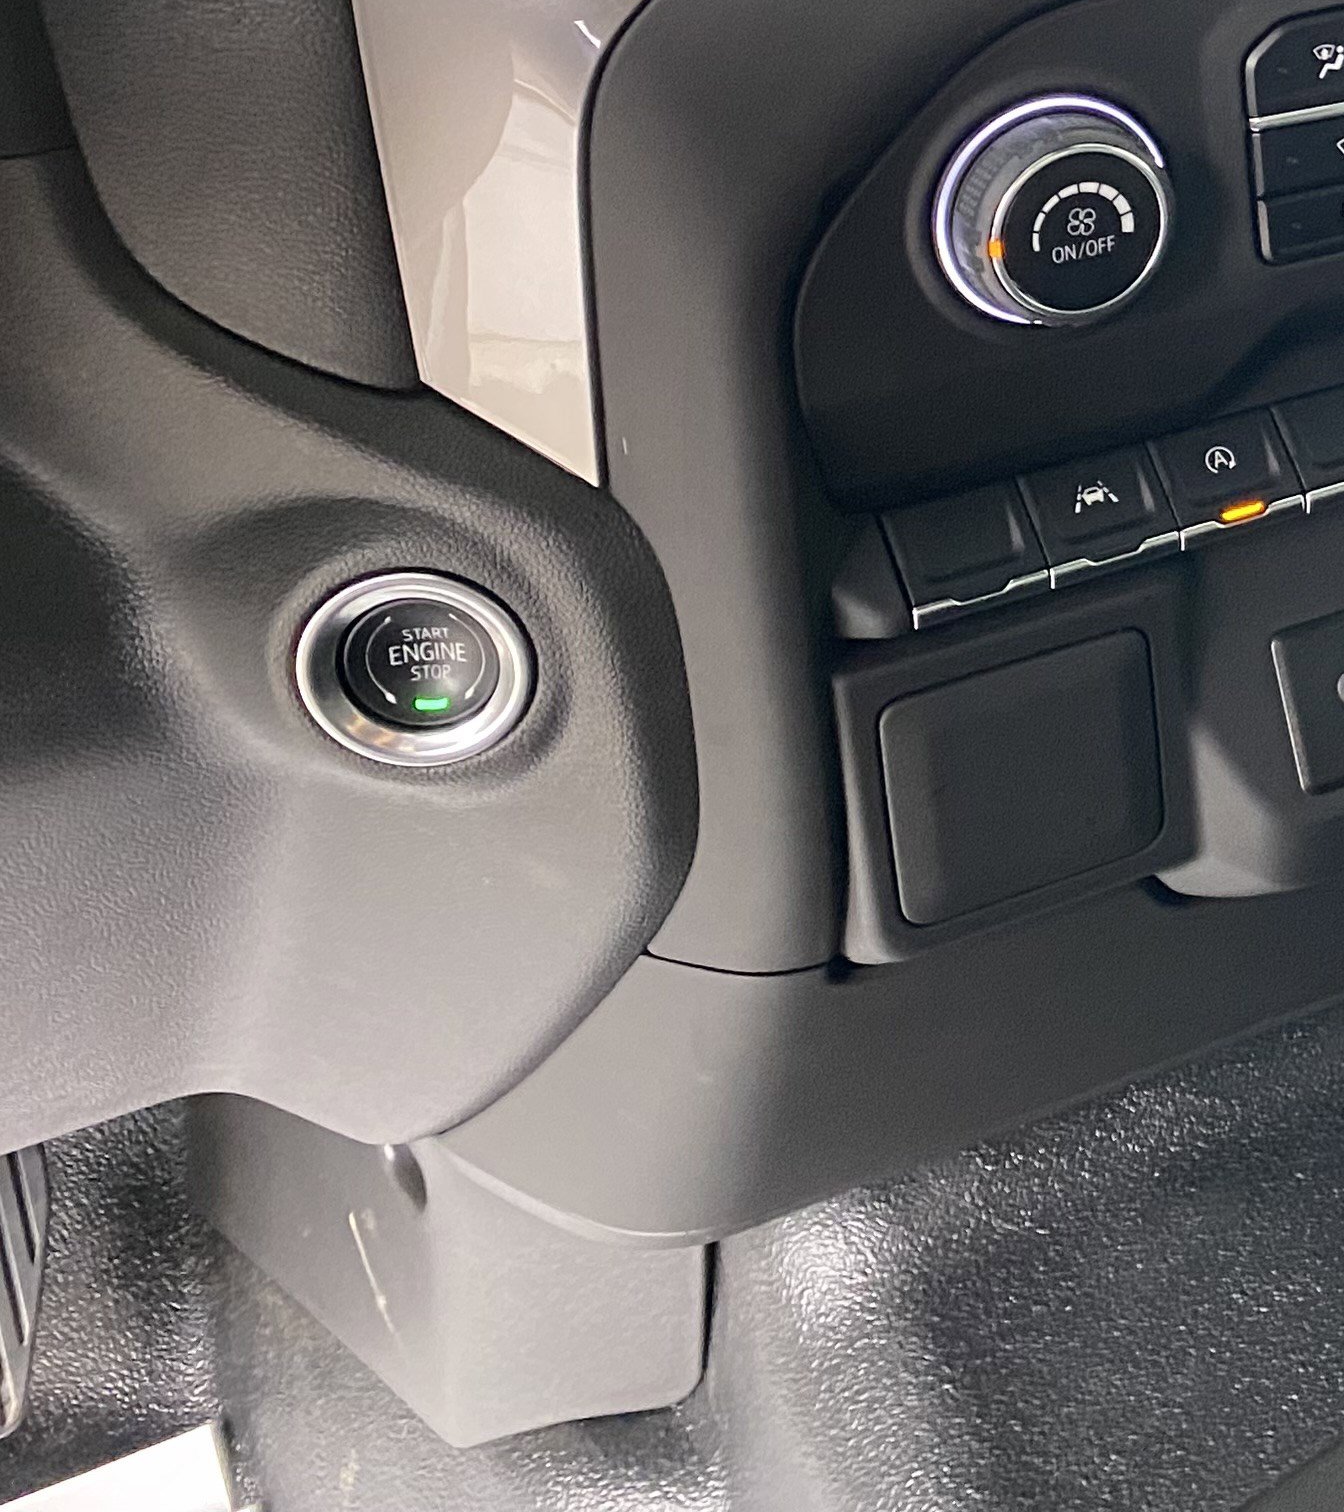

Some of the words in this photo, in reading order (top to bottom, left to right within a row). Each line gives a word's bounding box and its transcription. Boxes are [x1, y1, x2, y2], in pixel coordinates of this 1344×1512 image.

[1051, 235, 1116, 265] ON/OFF
[401, 627, 449, 642] START
[388, 642, 468, 667] ENGINE
[409, 664, 451, 682] STOP
